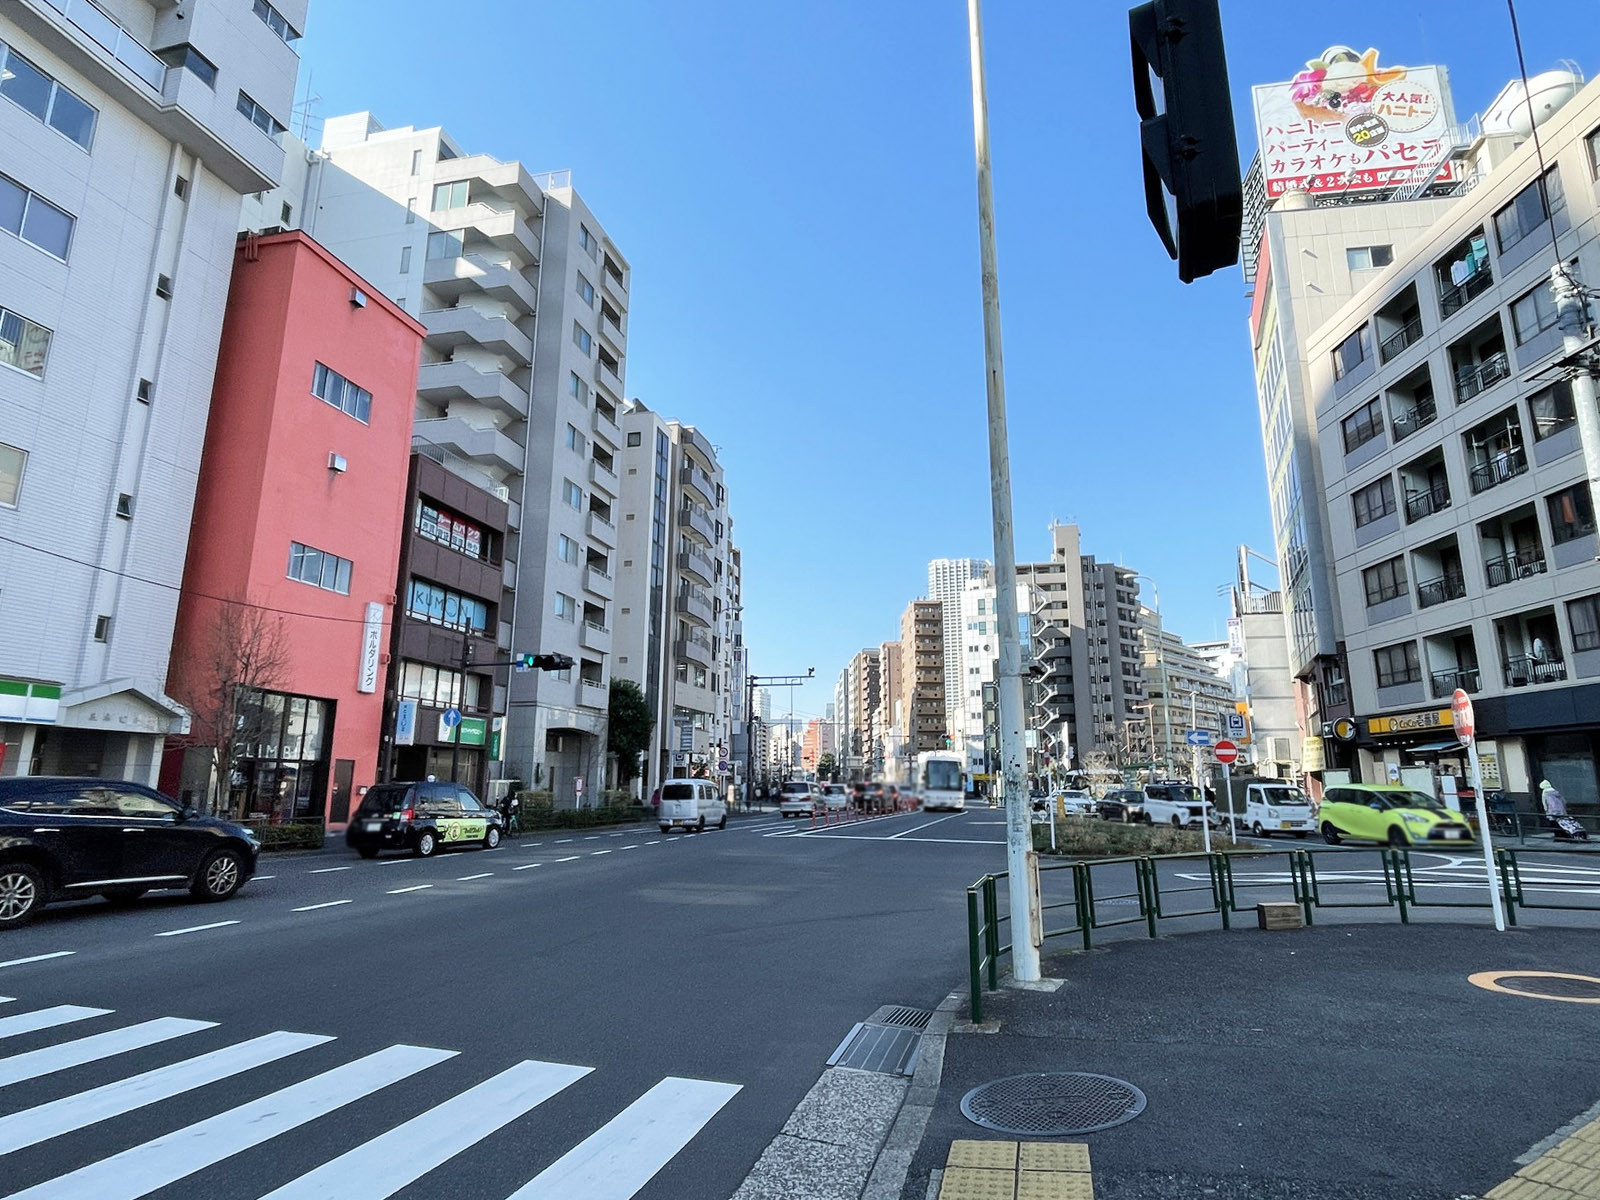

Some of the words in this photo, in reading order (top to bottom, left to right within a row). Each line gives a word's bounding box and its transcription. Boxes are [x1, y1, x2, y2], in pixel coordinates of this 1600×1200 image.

[1382, 91, 1429, 104] 大人気!
[1377, 104, 1431, 117] ハニトー
[1265, 119, 1341, 137] ハニトー
[1267, 138, 1344, 155] パーティー
[415, 590, 469, 618] KUMON
